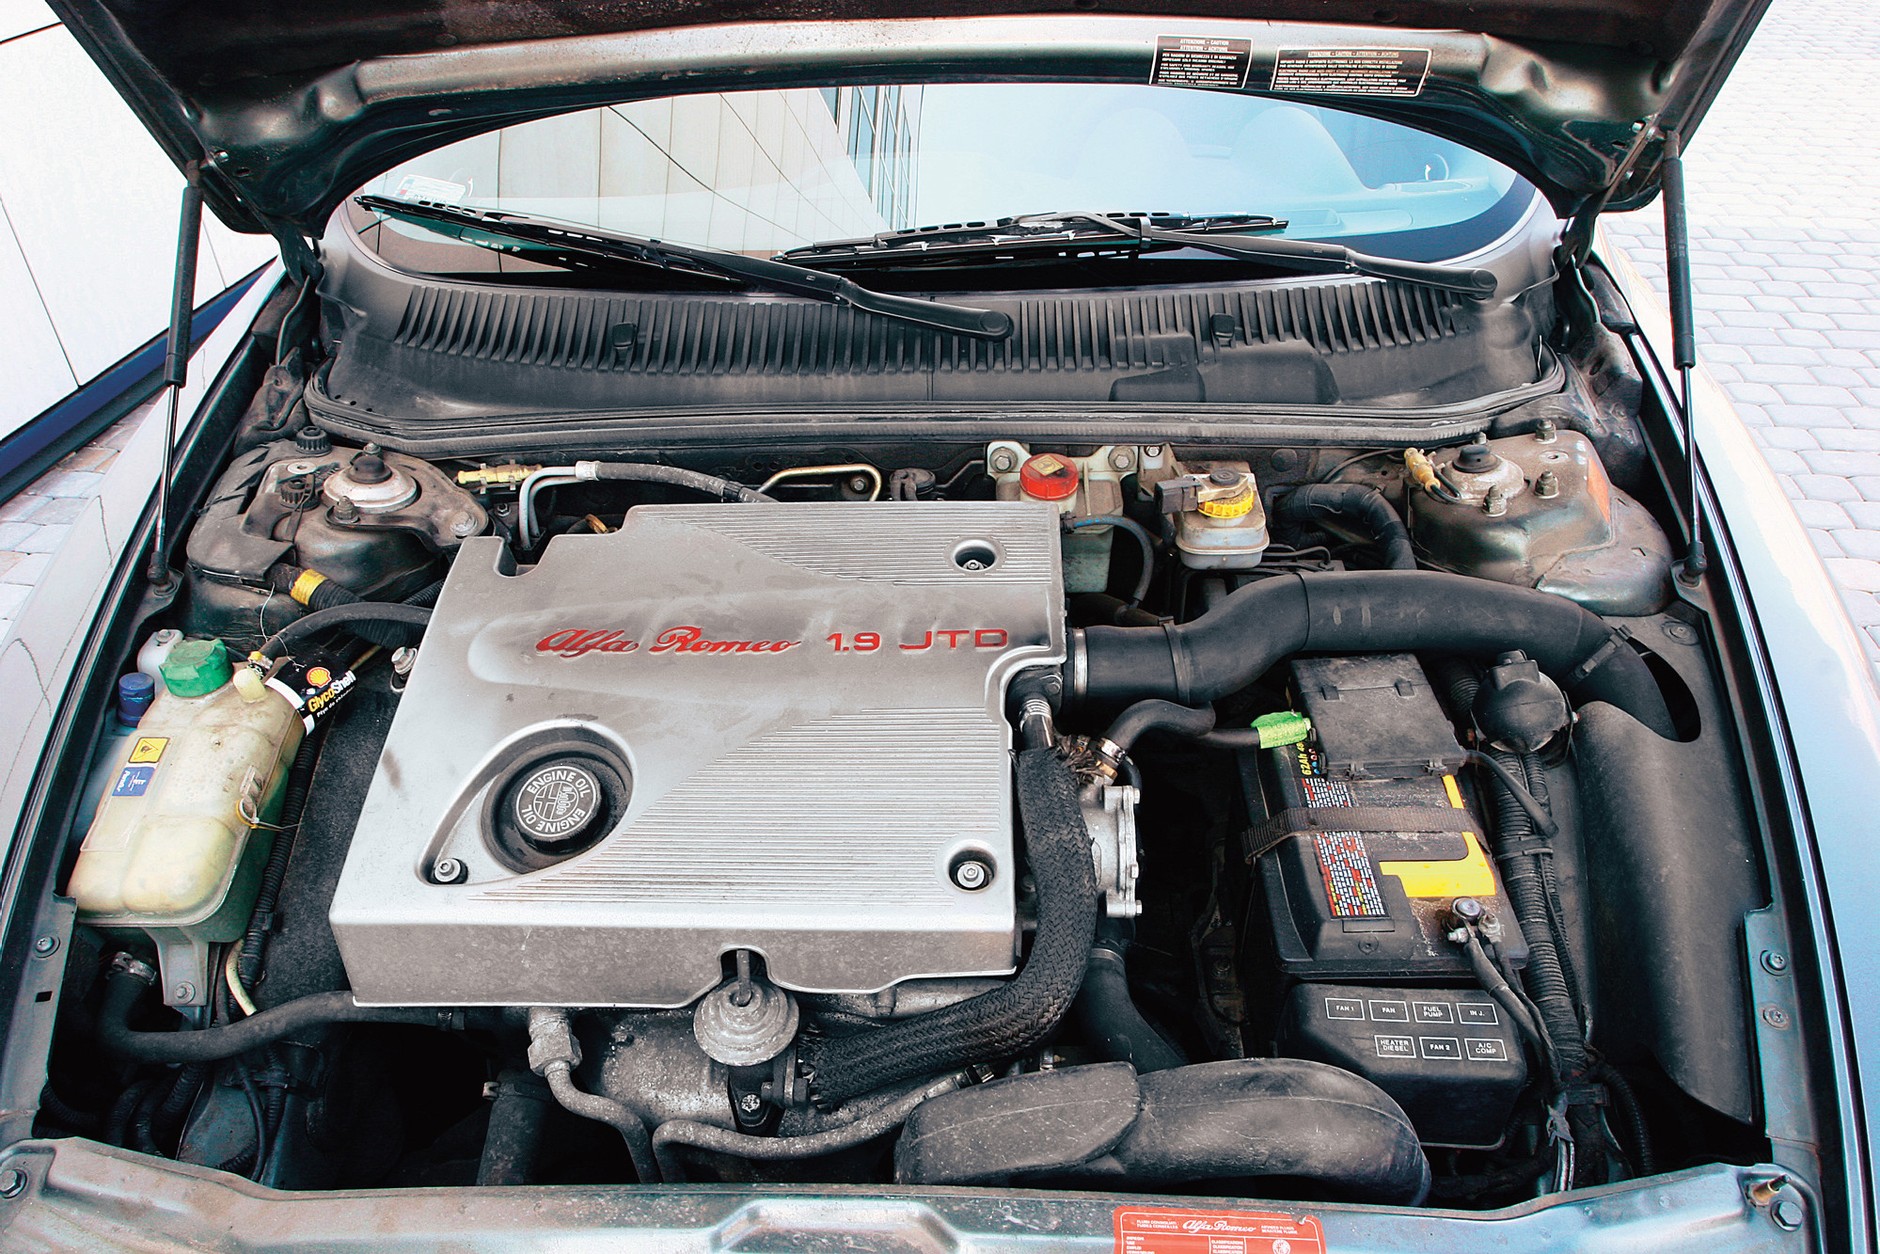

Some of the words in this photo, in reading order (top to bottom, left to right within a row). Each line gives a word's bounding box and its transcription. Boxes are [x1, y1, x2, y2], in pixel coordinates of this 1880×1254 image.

[535, 628, 639, 658] Alfa
[649, 625, 801, 654] Romeo
[826, 632, 881, 652] 1.9
[899, 628, 1009, 650] JTD
[308, 669, 357, 713] GlycoShell
[527, 770, 577, 795] ENGINE
[575, 778, 591, 798] OIL
[521, 804, 537, 825] OIL
[535, 808, 586, 833] ENGINE
[1182, 1220, 1214, 1233] Alfa
[1213, 1220, 1257, 1232] Romeo
